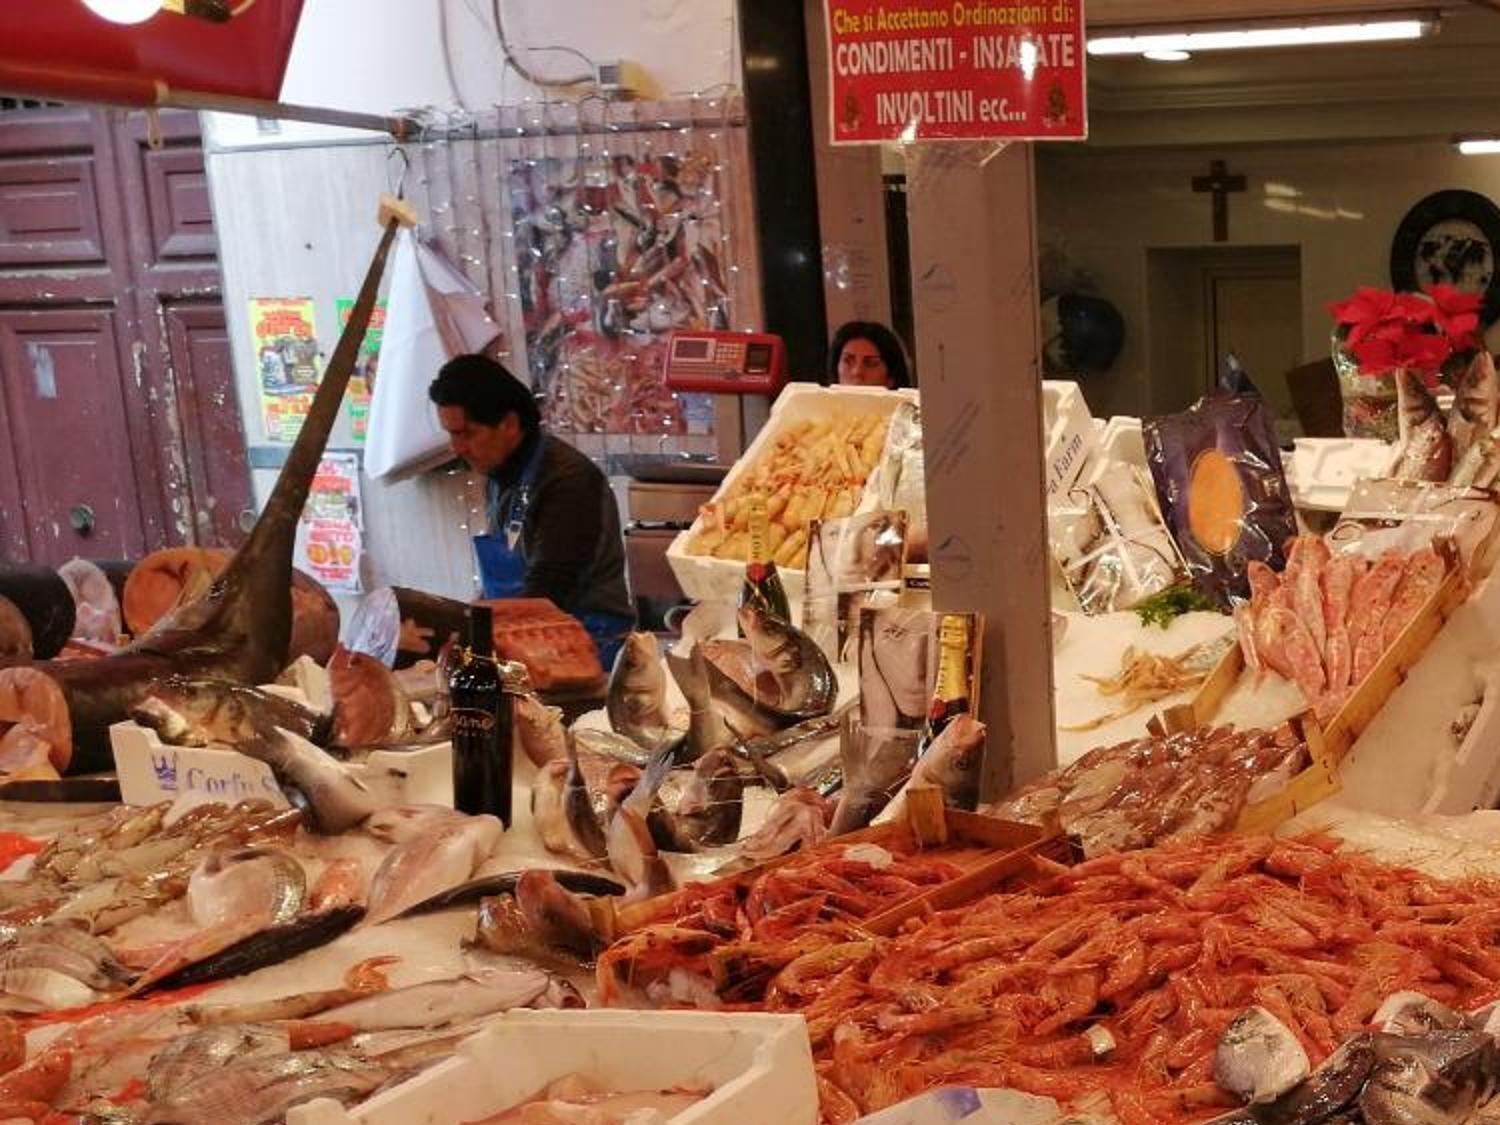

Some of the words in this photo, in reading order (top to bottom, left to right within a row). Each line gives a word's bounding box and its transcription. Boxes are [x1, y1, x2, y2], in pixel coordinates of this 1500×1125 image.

[833, 9, 861, 33] Che
[877, 7, 948, 30] Accettano
[953, 1, 1047, 27] Ordinazioni
[836, 37, 953, 76] CONDIMENTI
[973, 33, 1075, 69] INSAATE
[876, 90, 973, 125] INVOLTINI
